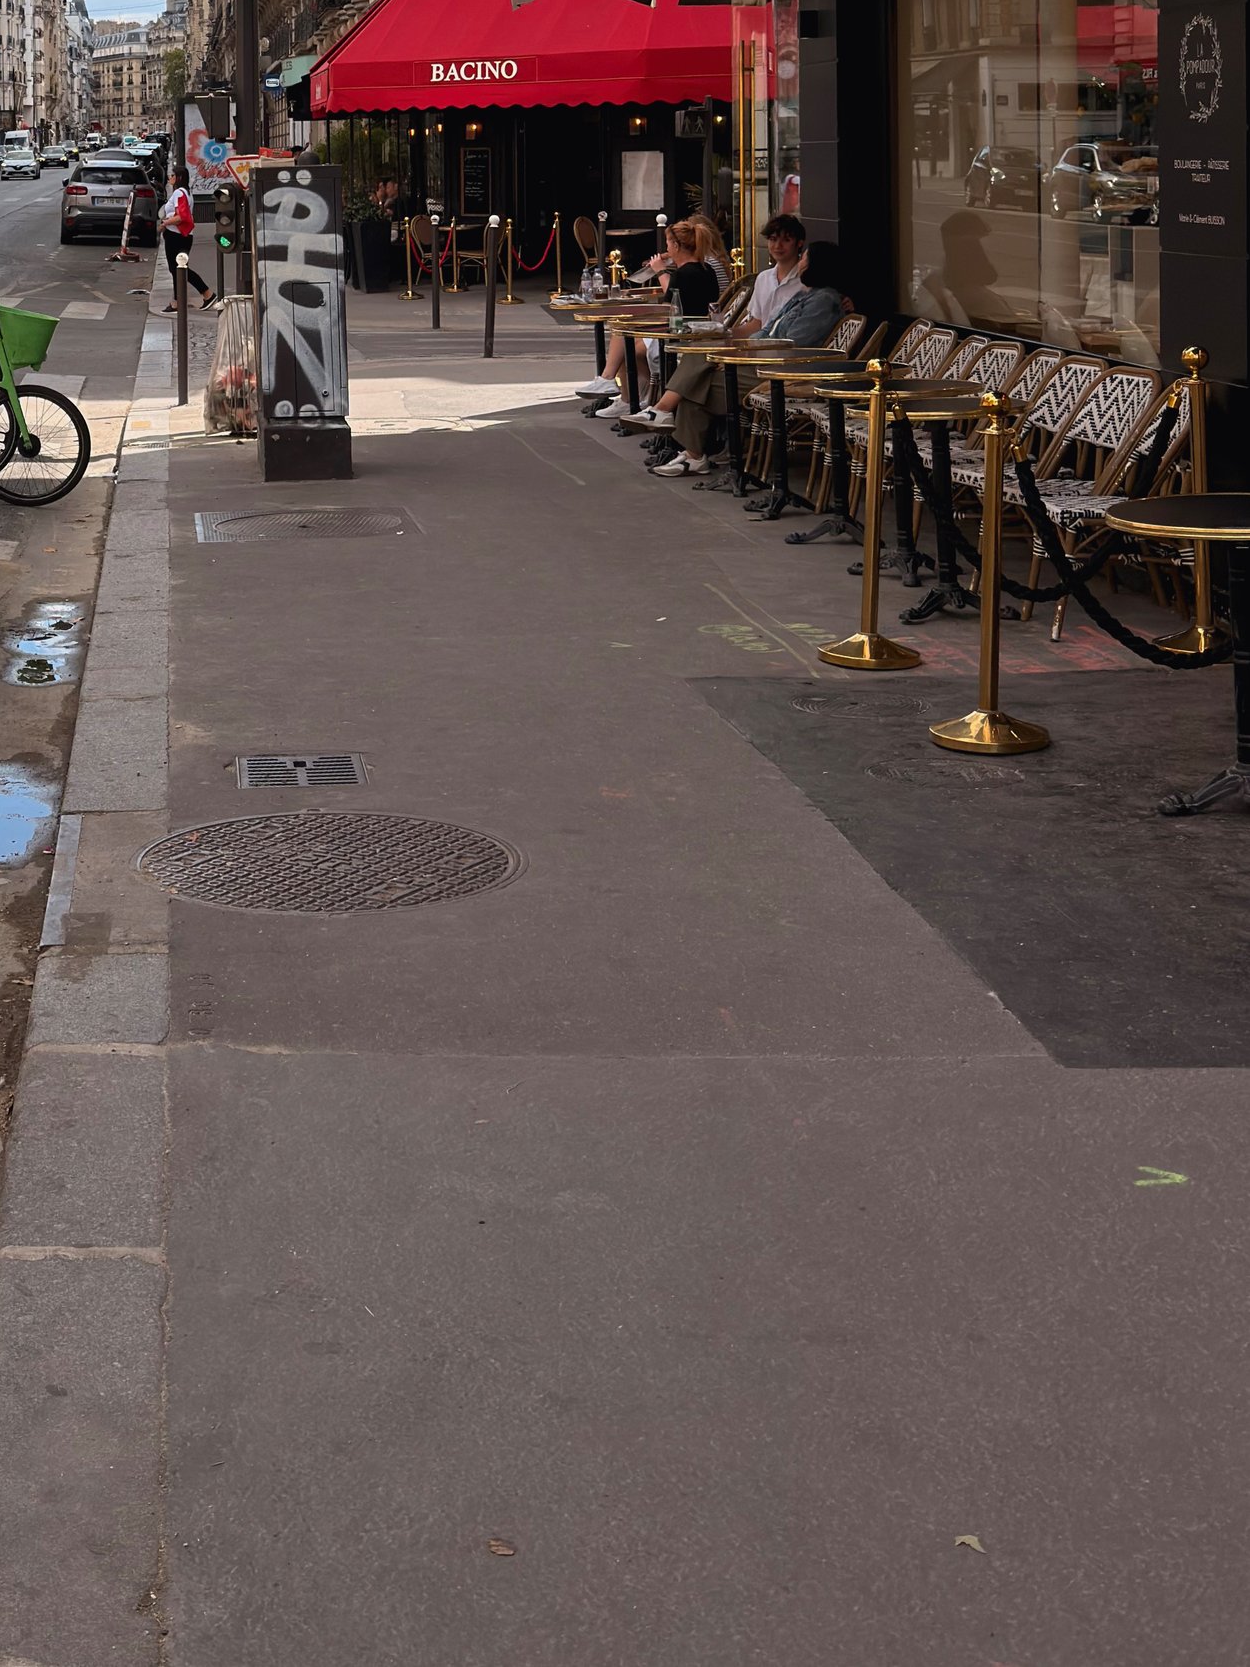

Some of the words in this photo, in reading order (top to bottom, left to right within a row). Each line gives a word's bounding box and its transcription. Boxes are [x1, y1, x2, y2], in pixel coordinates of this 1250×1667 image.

[1196, 42, 1204, 58] LA
[430, 60, 518, 82] BACINO
[1186, 59, 1216, 75] POMPADOUR
[1173, 160, 1201, 169] BOULANGERIE
